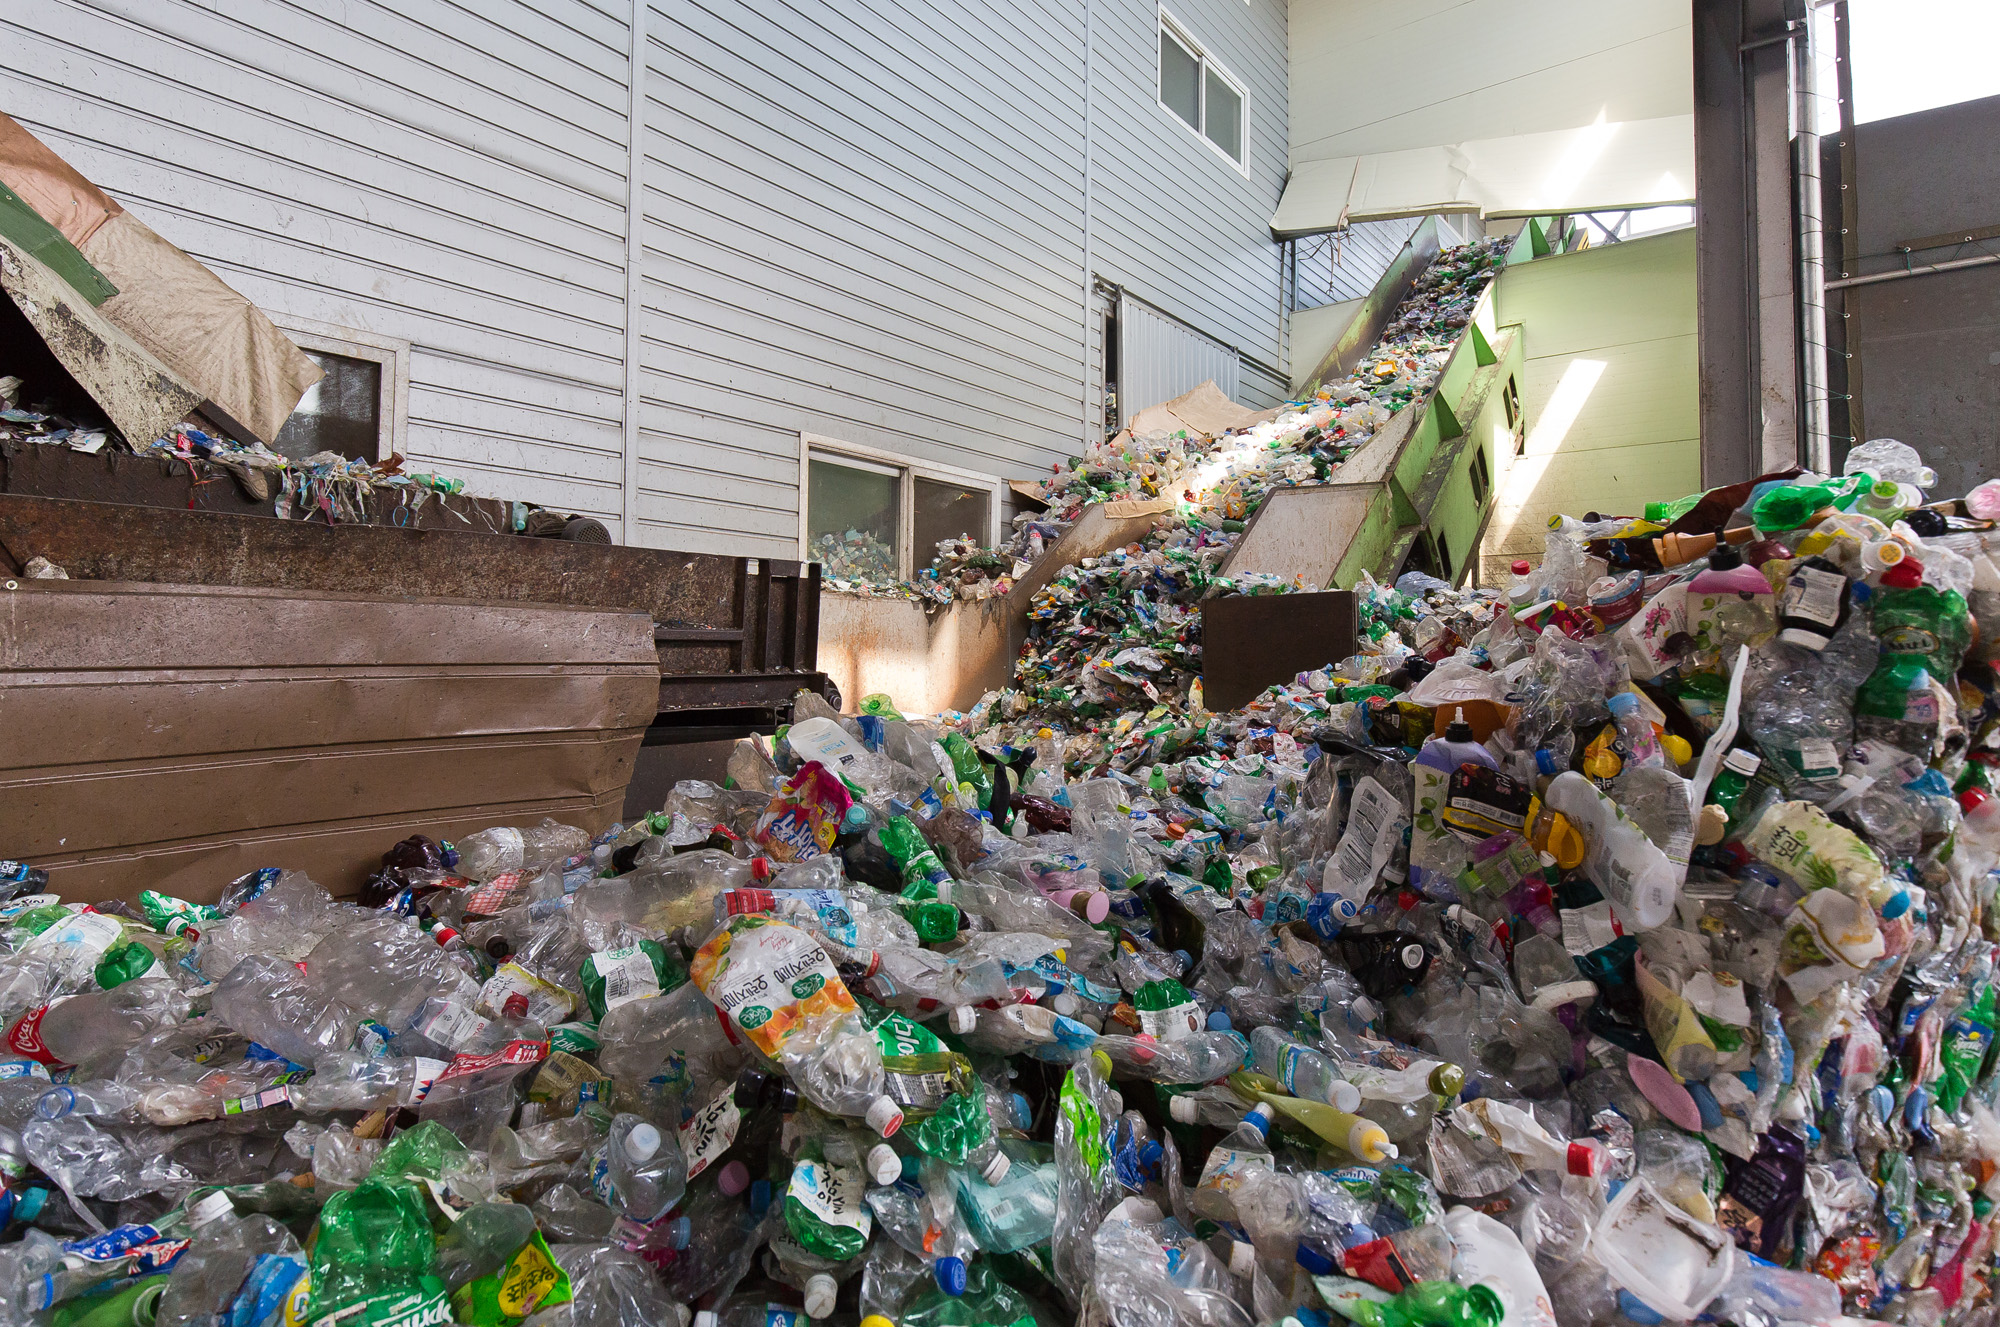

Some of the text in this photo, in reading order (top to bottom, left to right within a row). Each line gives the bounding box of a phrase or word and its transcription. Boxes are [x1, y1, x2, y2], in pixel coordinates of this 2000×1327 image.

[773, 947, 826, 984] 오렌지100
[720, 974, 768, 1012] 오렌지100
[15, 1007, 44, 1052] Coca-C
[506, 1266, 555, 1303] 양조식초
